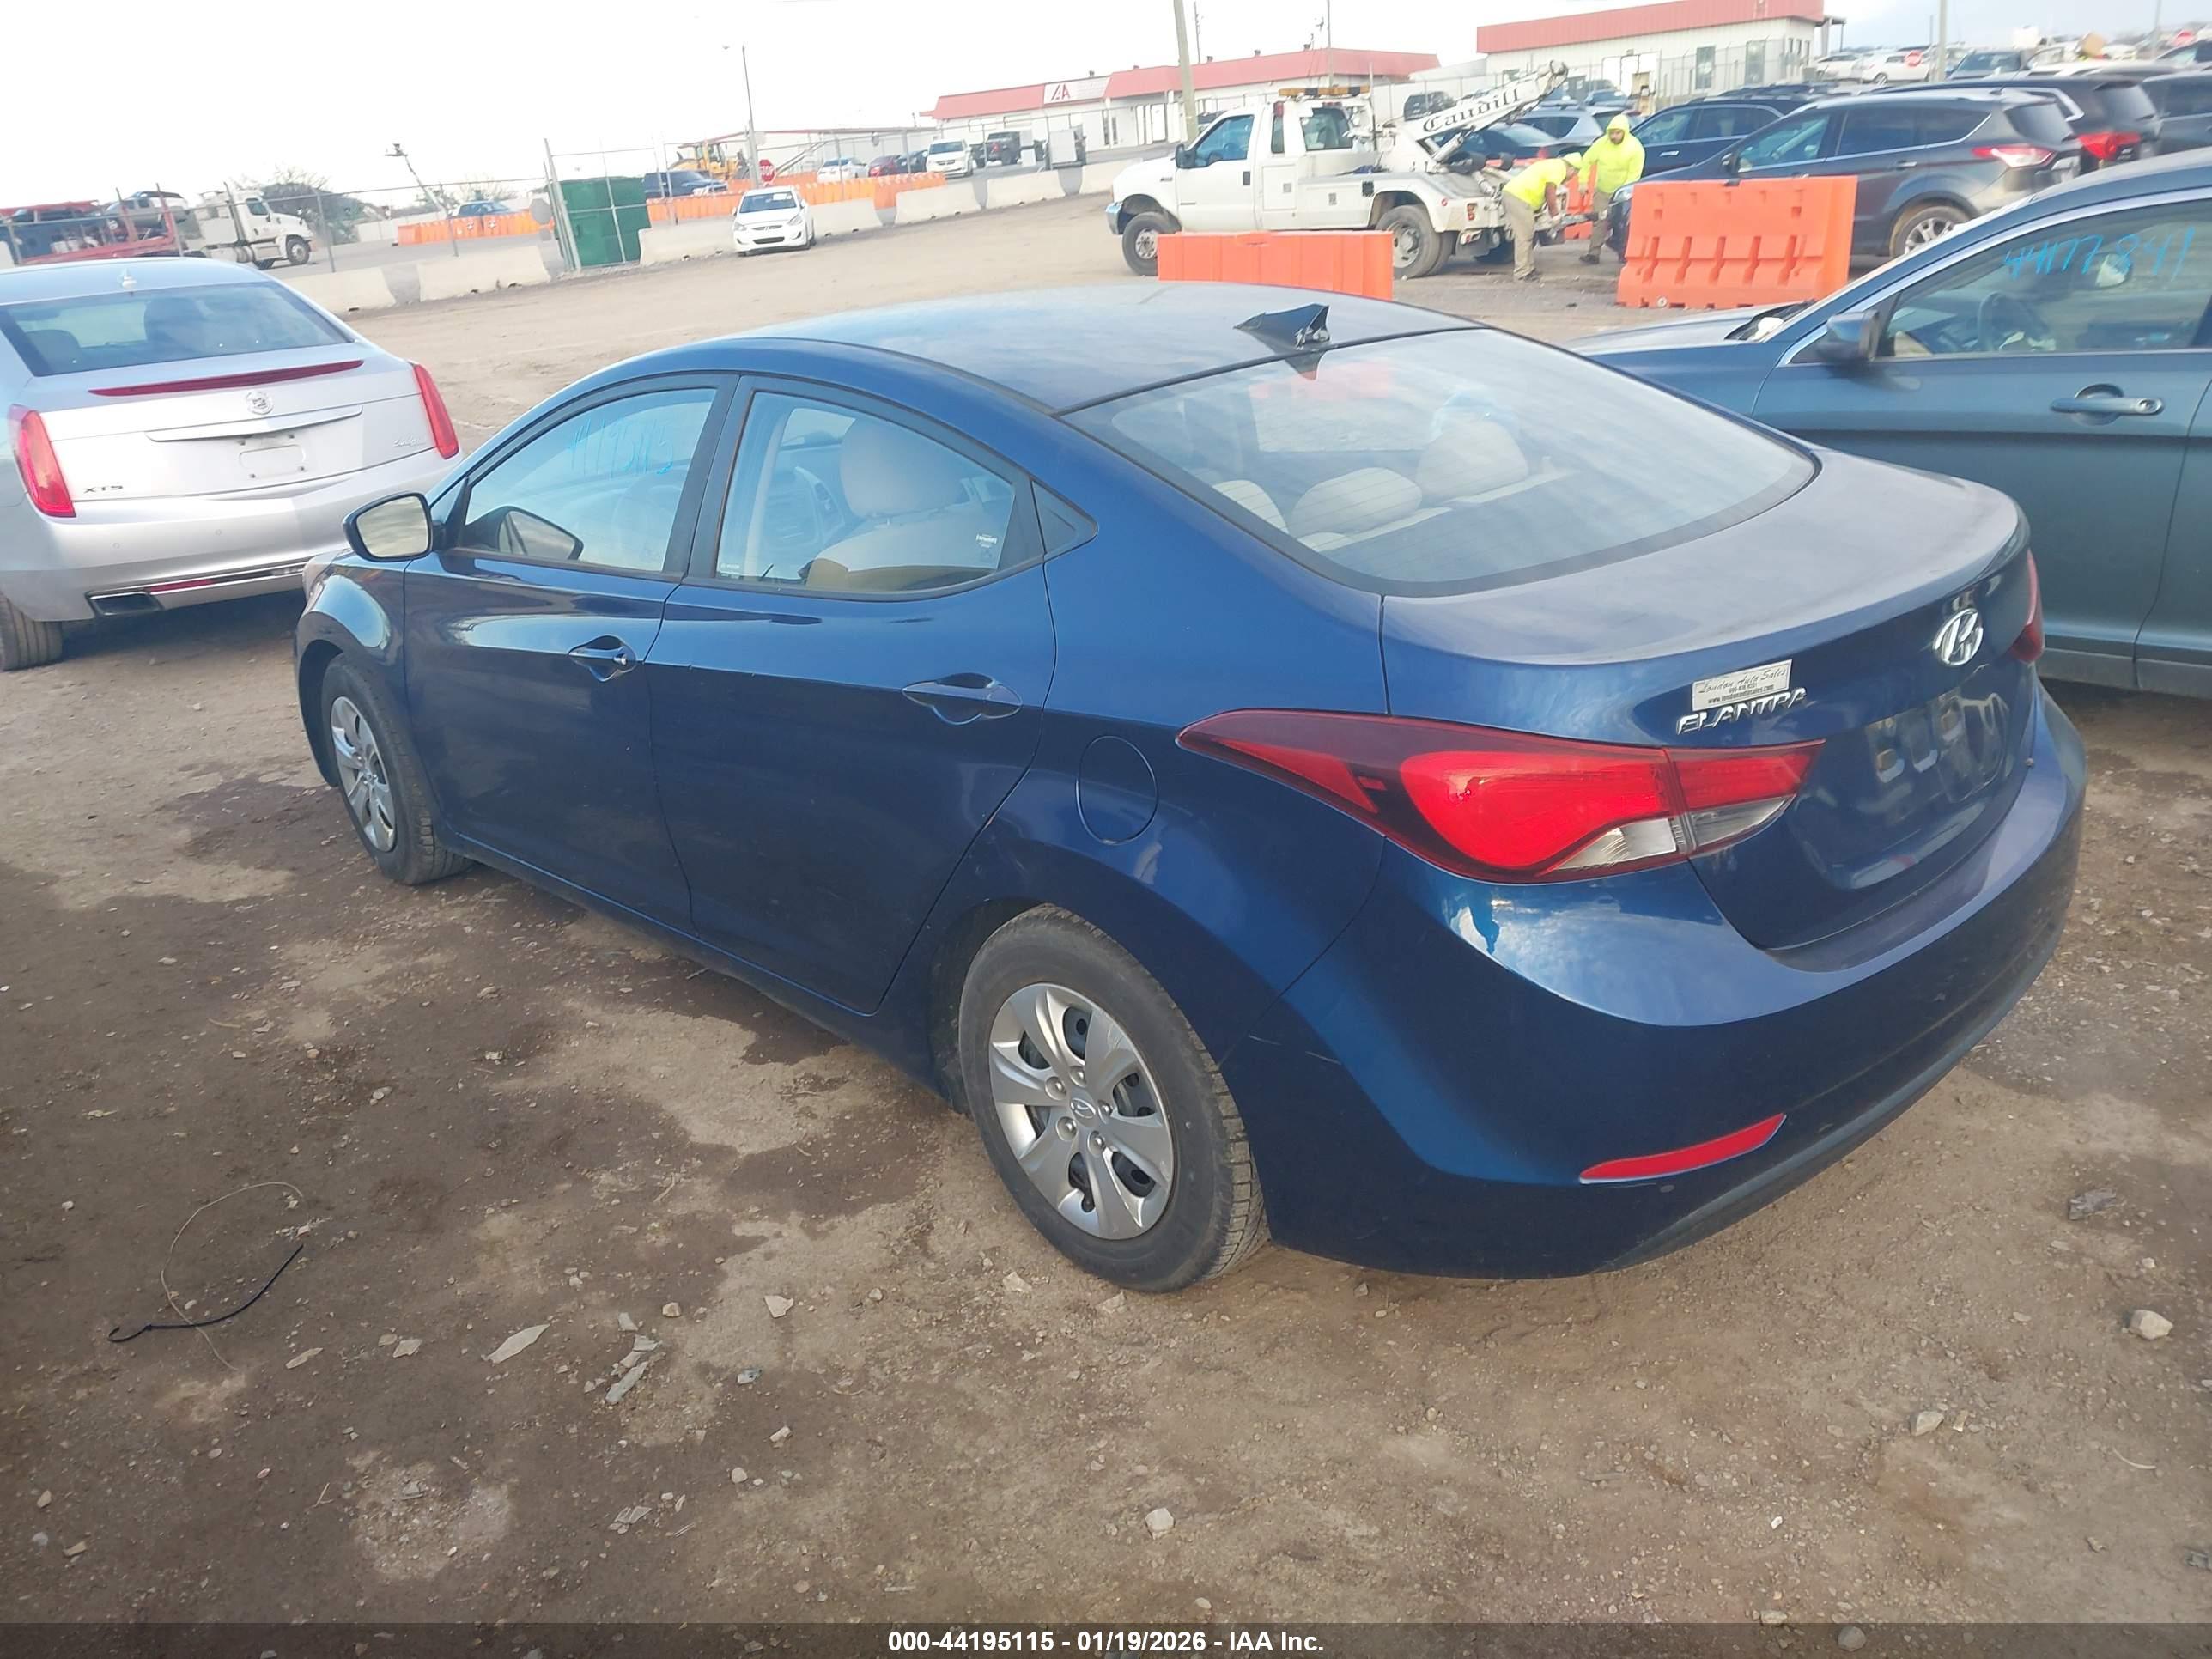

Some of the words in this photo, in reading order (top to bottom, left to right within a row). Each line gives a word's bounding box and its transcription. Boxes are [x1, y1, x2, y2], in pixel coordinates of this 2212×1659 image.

[1422, 88, 1520, 132] Caudill
[82, 484, 124, 495] XTS
[1676, 687, 1807, 735] ELANTRA
